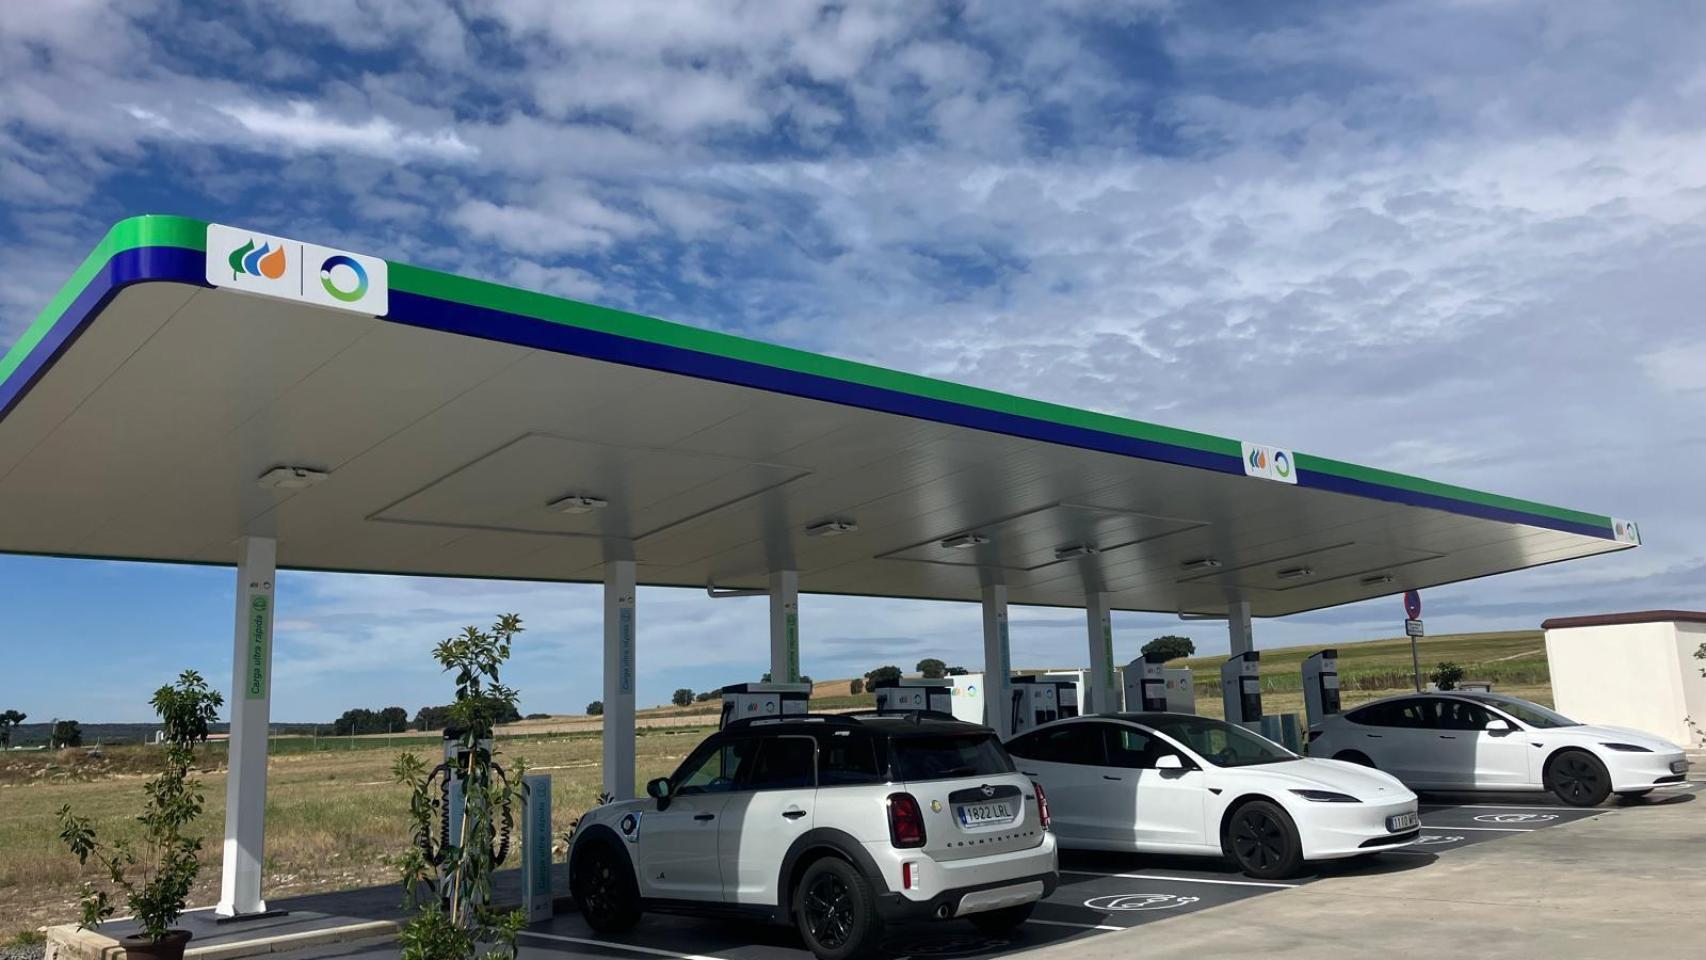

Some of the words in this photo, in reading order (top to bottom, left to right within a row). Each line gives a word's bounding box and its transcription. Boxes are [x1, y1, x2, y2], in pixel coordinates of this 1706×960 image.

[254, 615, 265, 644] rápida
[253, 646, 262, 666] ultra
[251, 668, 262, 695] Carga
[967, 806, 992, 821] 1822
[993, 804, 1012, 817] LRL
[947, 831, 1034, 848] COUNTRYMAN
